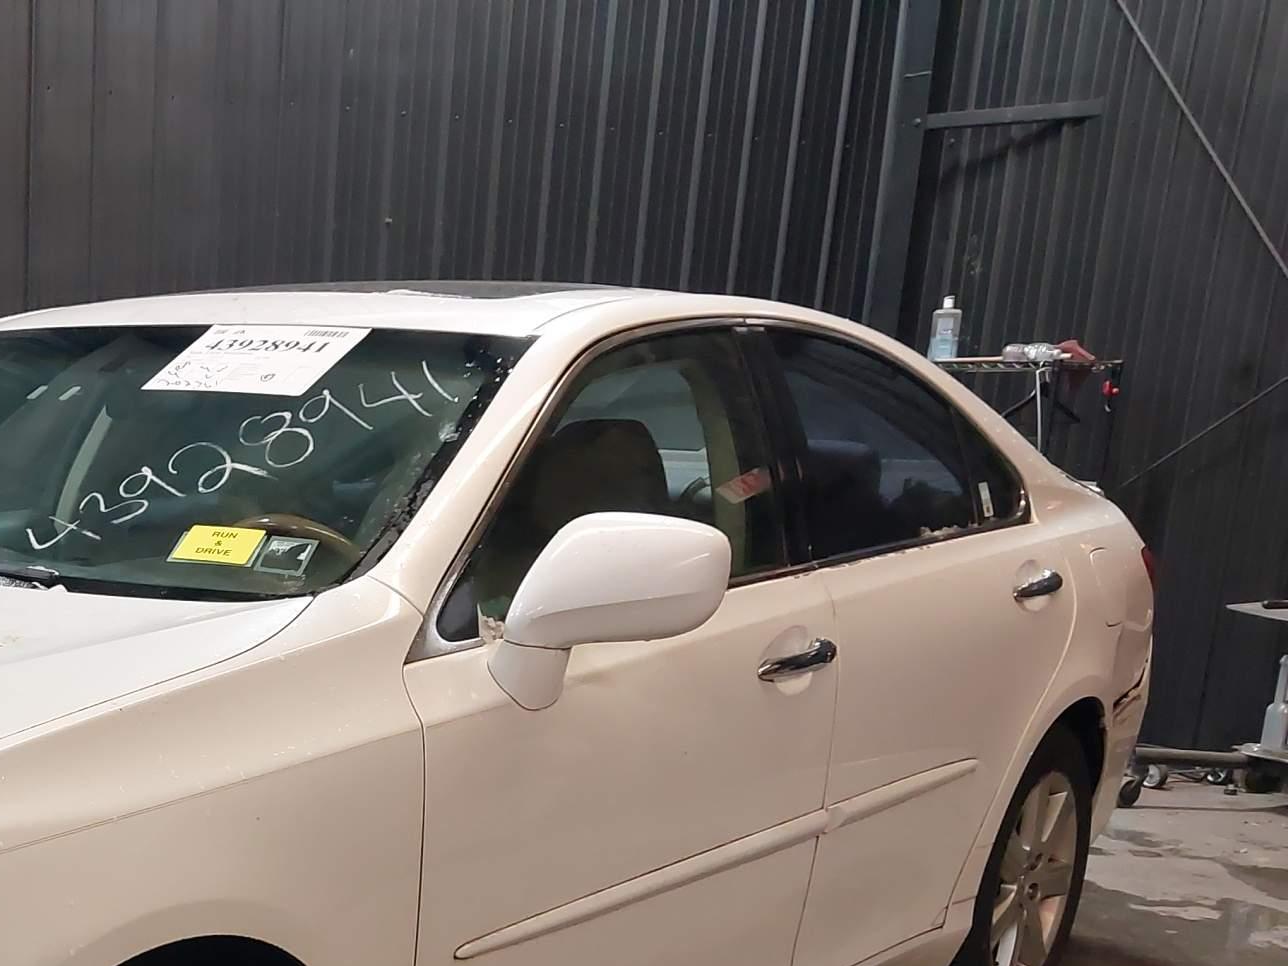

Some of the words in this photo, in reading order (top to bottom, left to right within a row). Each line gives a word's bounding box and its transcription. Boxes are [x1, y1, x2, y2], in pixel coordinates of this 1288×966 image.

[205, 339, 330, 352] 43928941
[26, 361, 459, 551] 43928941
[211, 530, 239, 539] RUN
[195, 547, 232, 556] DRIVE
